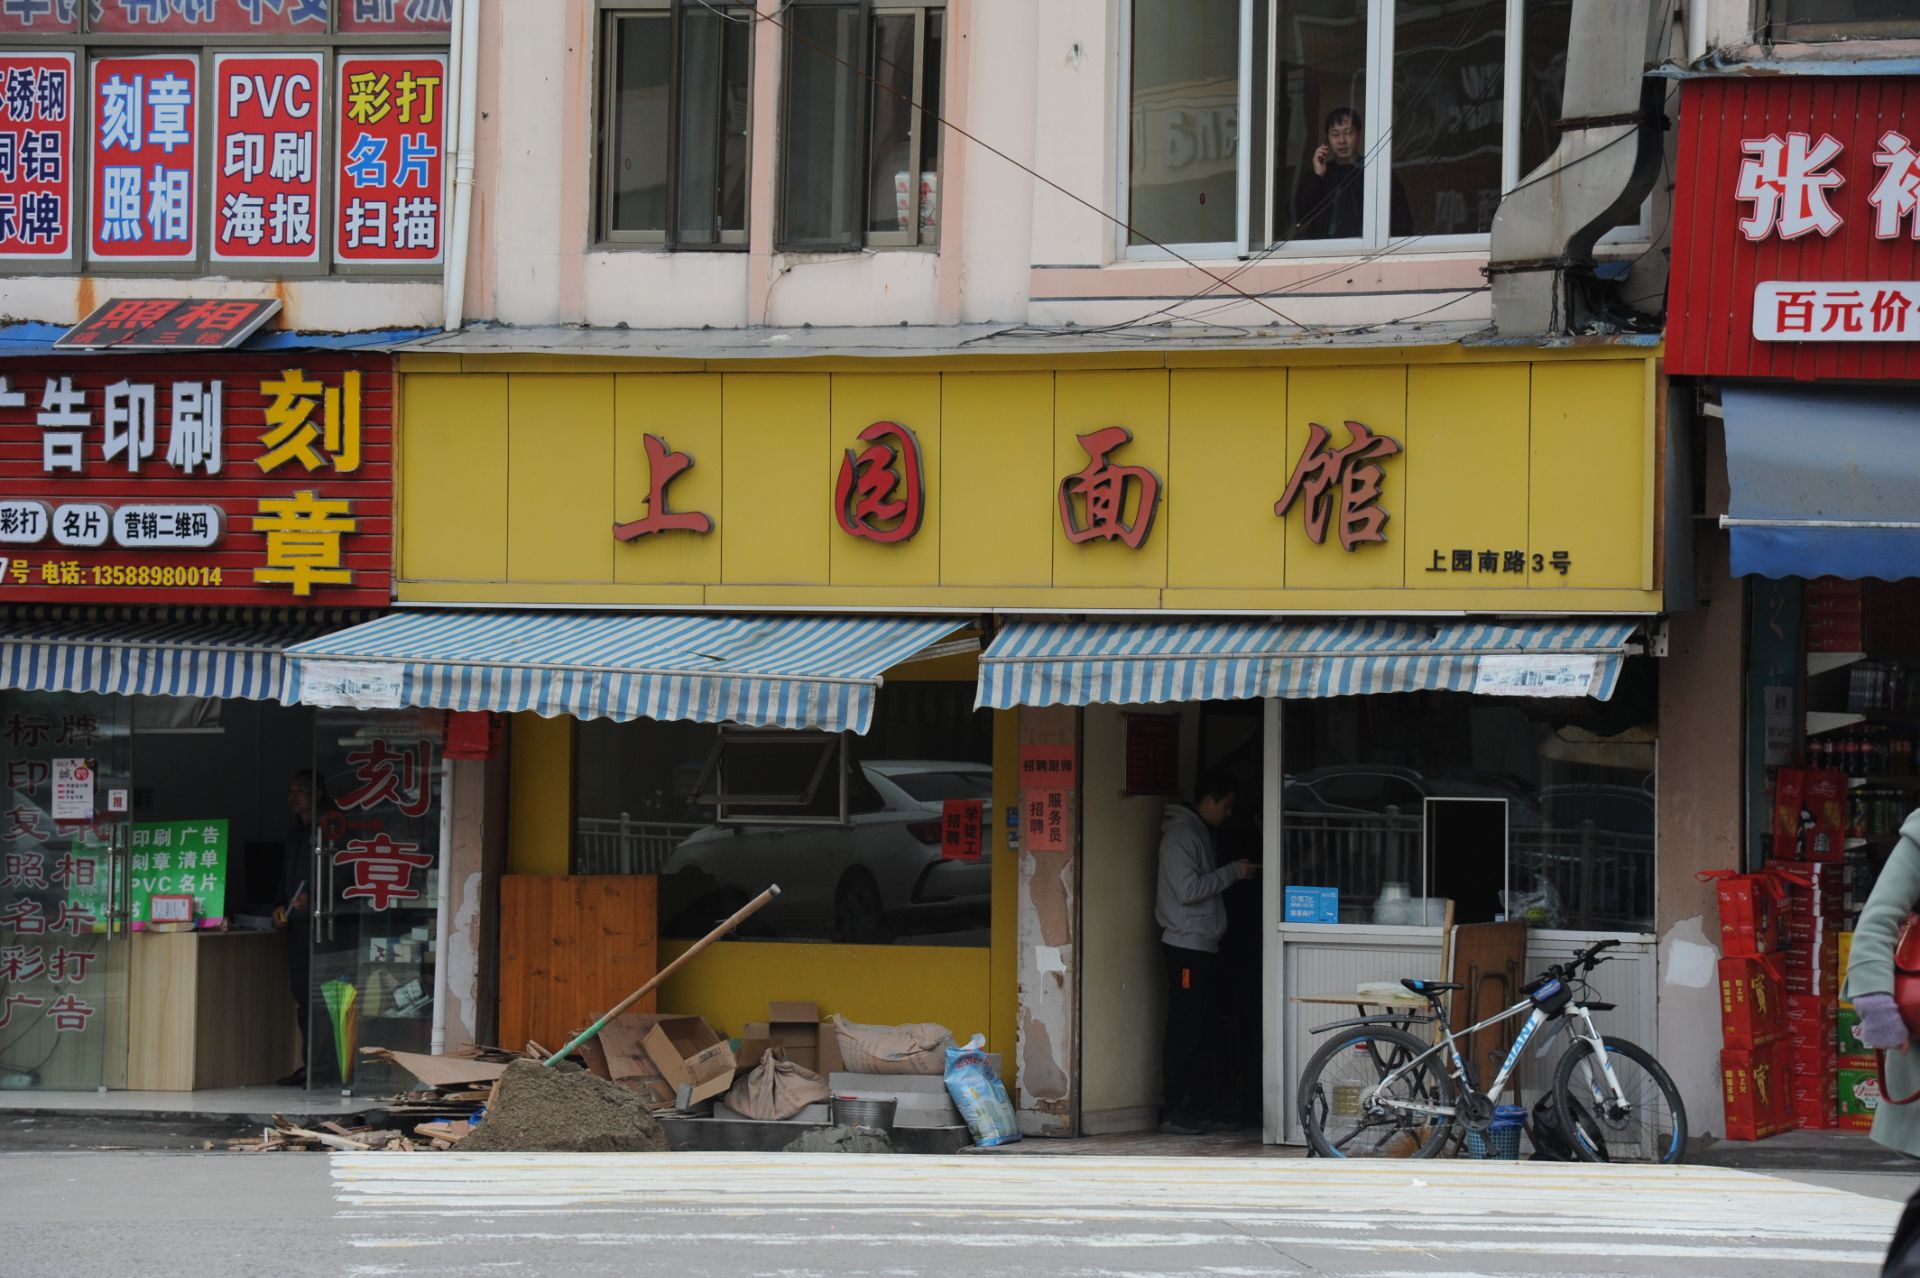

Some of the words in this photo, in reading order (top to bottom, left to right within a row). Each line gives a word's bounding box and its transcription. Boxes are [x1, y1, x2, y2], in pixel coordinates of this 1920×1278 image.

[0, 68, 66, 121] 锈钢
[101, 72, 191, 153] 刻章
[229, 75, 312, 118] PVC
[347, 71, 441, 125] 彩打
[223, 131, 314, 183] 印刷
[346, 133, 437, 188] 名片
[101, 164, 189, 242] 照相
[221, 193, 313, 246] 海报
[345, 197, 438, 249] 扫描
[87, 300, 260, 331] 照相
[1775, 290, 1920, 333] 百元价
[252, 369, 361, 596] 刻章
[0, 509, 39, 535] 彩打
[62, 511, 101, 538] 名片
[124, 513, 209, 539] 营销二维码
[92, 565, 222, 586] 13588980014
[1425, 550, 1571, 575] 上园南路3号
[4, 713, 98, 748] 标牌
[1024, 759, 1072, 772] 招聘厨师
[333, 738, 432, 911] 刻章
[946, 813, 961, 846] 招聘
[963, 806, 977, 855] 学徒工
[1030, 801, 1044, 834] 招聘
[1048, 793, 1062, 843] 服务员
[132, 828, 172, 848] 印刷
[179, 826, 220, 846] 广告
[0, 852, 96, 889] 照相
[132, 853, 171, 871] 刻章
[178, 850, 218, 870] 清单
[178, 874, 218, 893] 名片
[0, 898, 97, 935] 名片
[0, 946, 96, 983] 彩打
[0, 993, 95, 1031] 广告
[1502, 1016, 1537, 1071] GIANT
